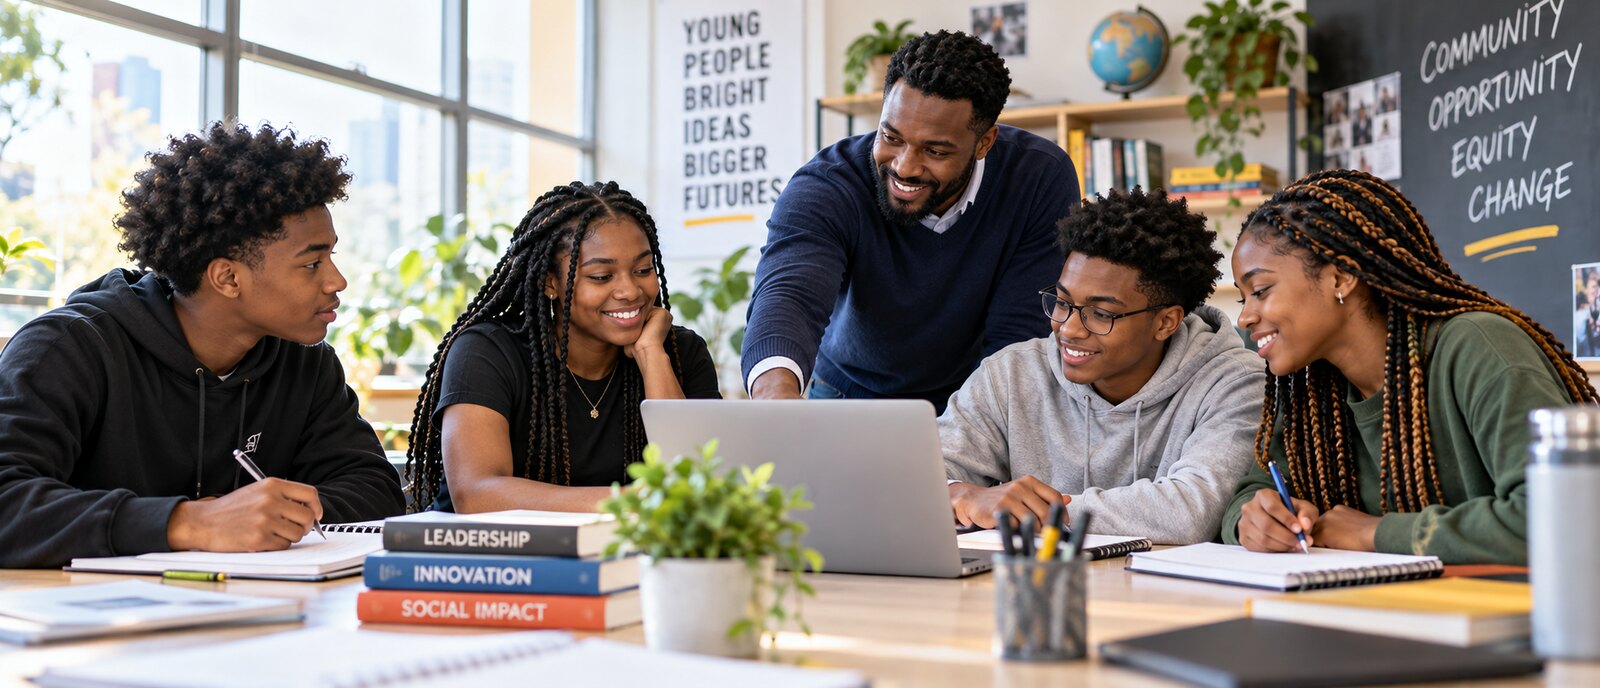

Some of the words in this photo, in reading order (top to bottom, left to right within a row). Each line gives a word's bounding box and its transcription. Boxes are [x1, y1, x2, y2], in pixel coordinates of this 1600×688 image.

[683, 11, 760, 44] YOUNG
[684, 43, 770, 78] PEOPLE
[684, 77, 769, 111] BRIGHT
[684, 114, 751, 144] IDEAS
[684, 146, 767, 178] BIGGER
[684, 178, 781, 211] FUTURES
[1468, 161, 1573, 223] CHANGE
[424, 529, 531, 548] LEADERSHIP
[414, 564, 532, 585] INNOVATION
[401, 600, 468, 618] SOCIAL
[475, 602, 547, 621] IMPACT
